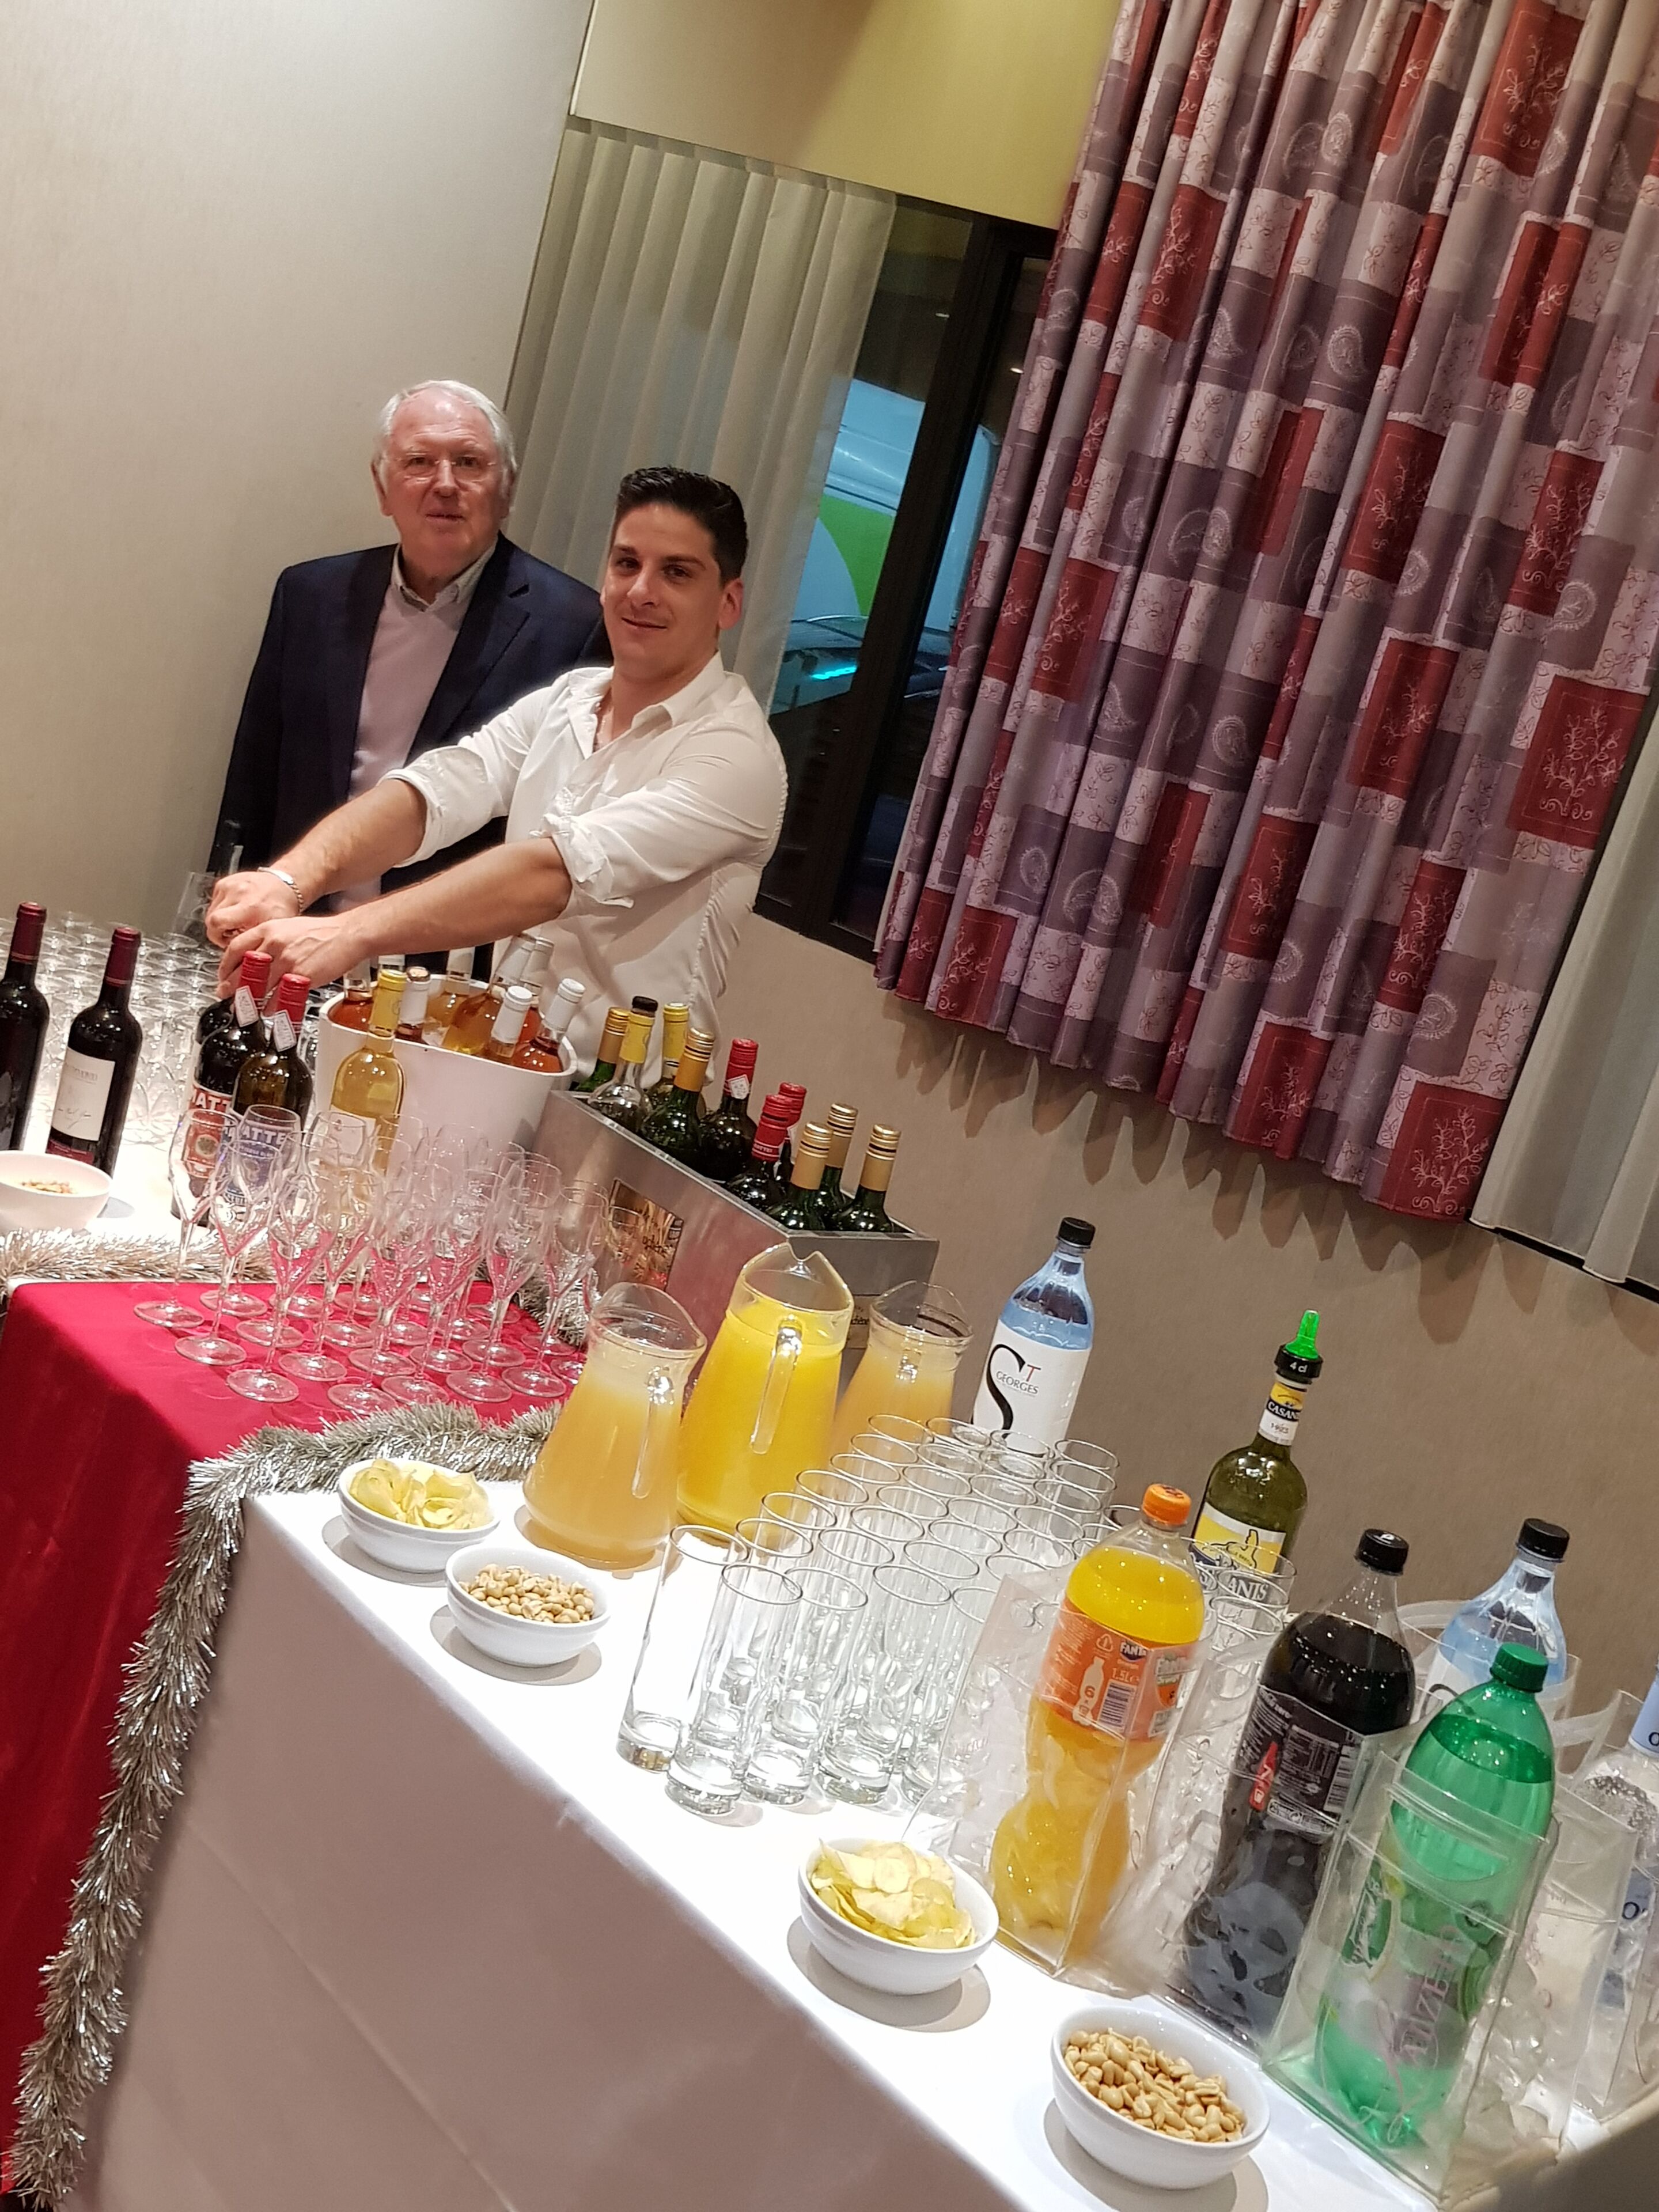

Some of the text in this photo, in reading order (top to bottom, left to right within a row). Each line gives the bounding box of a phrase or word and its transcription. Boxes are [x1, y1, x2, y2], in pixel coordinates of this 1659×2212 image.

[1290, 1362, 1308, 1373] 4 cl
[996, 1371, 1039, 1395] GEORGES
[1268, 1401, 1299, 1419] CASAN
[1228, 1577, 1269, 1601] ANIS
[1120, 1642, 1146, 1656] FANTA
[1085, 1685, 1096, 1698] 6
